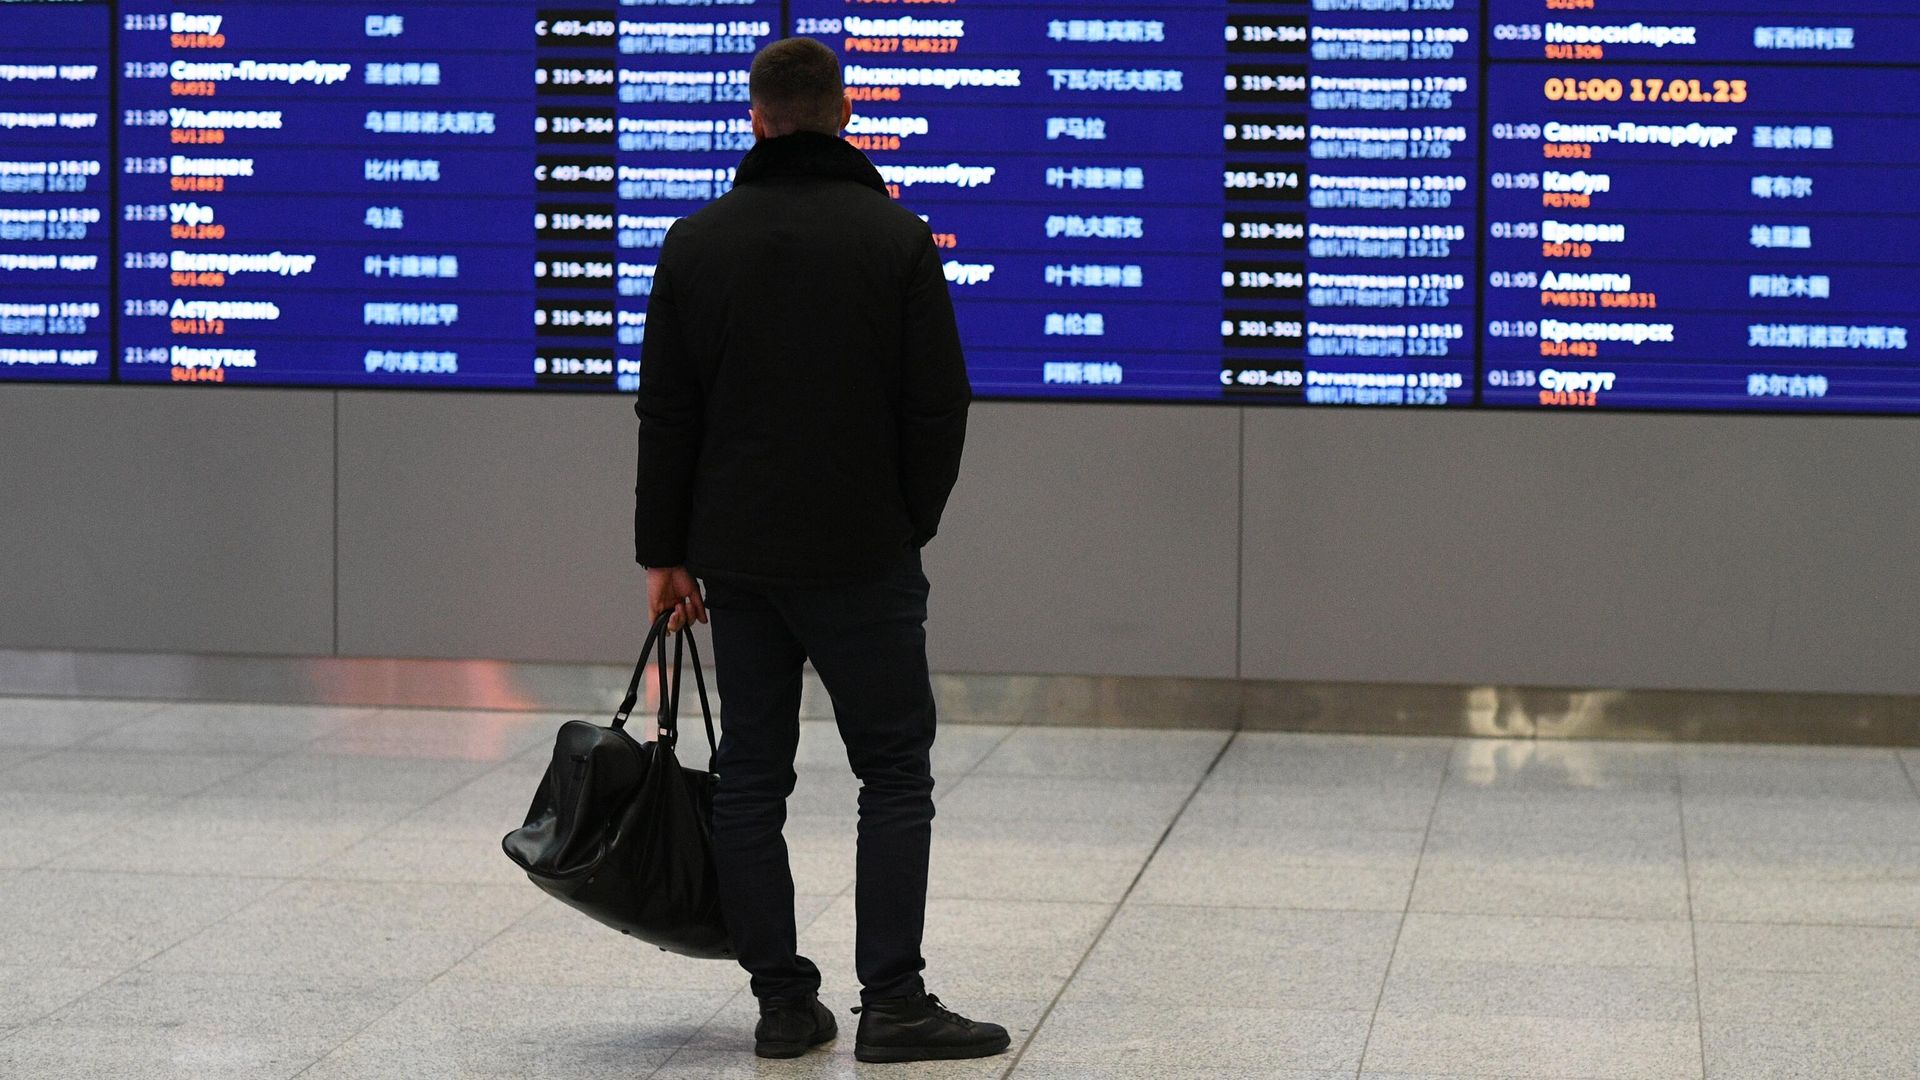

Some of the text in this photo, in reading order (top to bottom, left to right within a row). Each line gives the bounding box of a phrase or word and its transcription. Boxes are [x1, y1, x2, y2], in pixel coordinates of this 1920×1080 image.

[170, 12, 222, 35] Баку
[844, 16, 965, 38] Челябинск
[1545, 22, 1696, 47] Новосибирск
[170, 60, 351, 84] Санкт-Петербург
[1544, 78, 1748, 103] 01:00 17.01.23
[169, 108, 282, 129] Ульяновск
[844, 114, 928, 138] Самара
[1543, 122, 1737, 147] Санкт-Петербург
[170, 155, 254, 176] Бишкек
[875, 163, 996, 188] теринбург
[1543, 171, 1610, 195] Кабул
[170, 202, 214, 227] Уфа
[1542, 220, 1625, 244] Ереван
[171, 251, 316, 277] Екатеринбург
[1540, 270, 1634, 294] Алматы
[170, 299, 280, 322] Астрахань
[1540, 319, 1674, 345] Красноярск
[171, 346, 256, 369] Иркутск
[1539, 368, 1616, 395] Сургут
